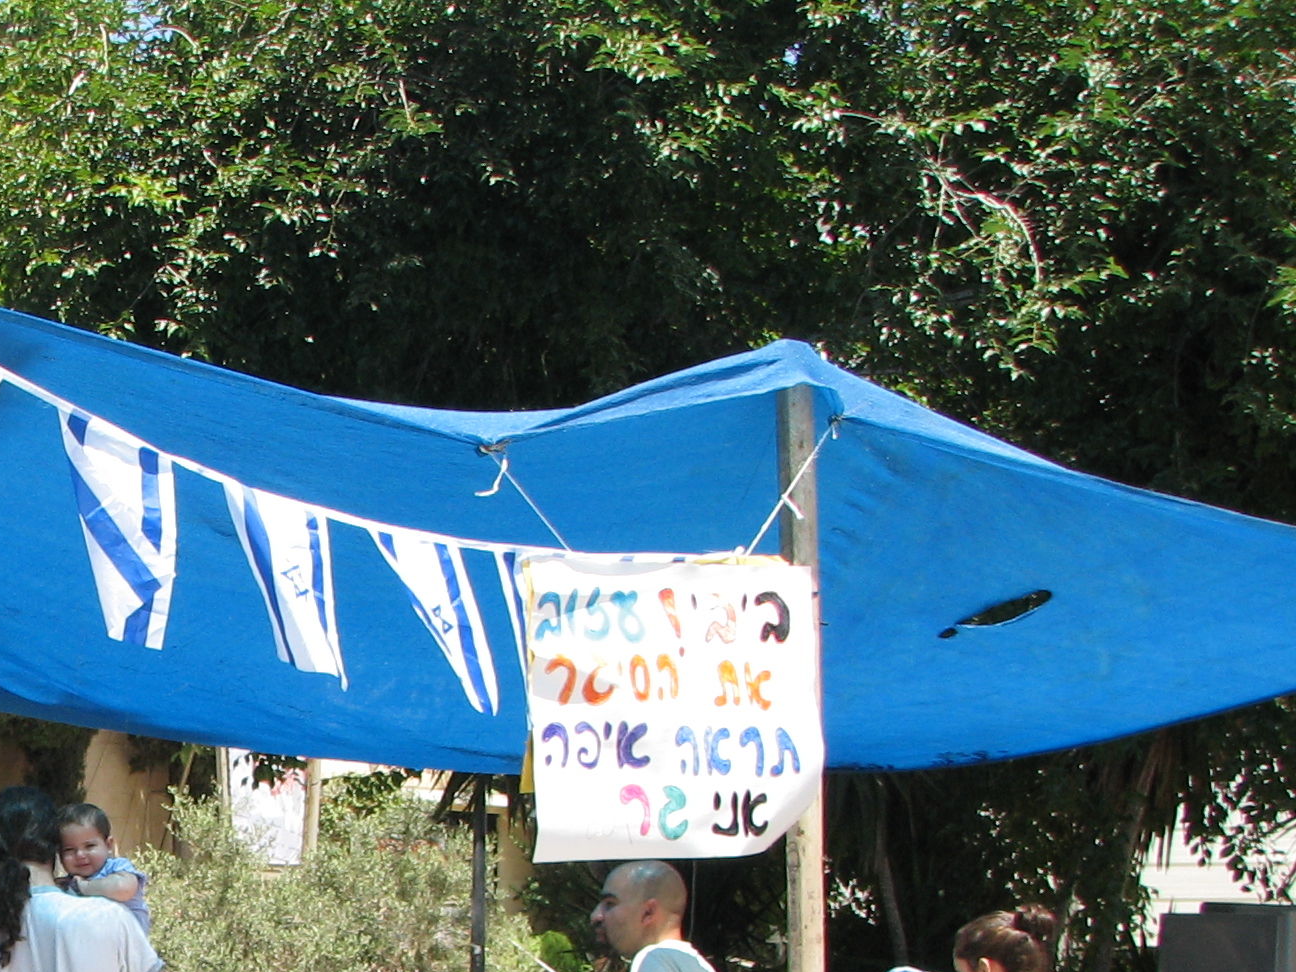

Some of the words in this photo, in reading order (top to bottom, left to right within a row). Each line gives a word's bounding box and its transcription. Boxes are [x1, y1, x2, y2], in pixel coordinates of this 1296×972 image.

[714, 660, 772, 710] את
[541, 720, 651, 770] איפה
[675, 725, 801, 777] תראה
[619, 784, 689, 840] גר
[712, 789, 770, 838] אני
